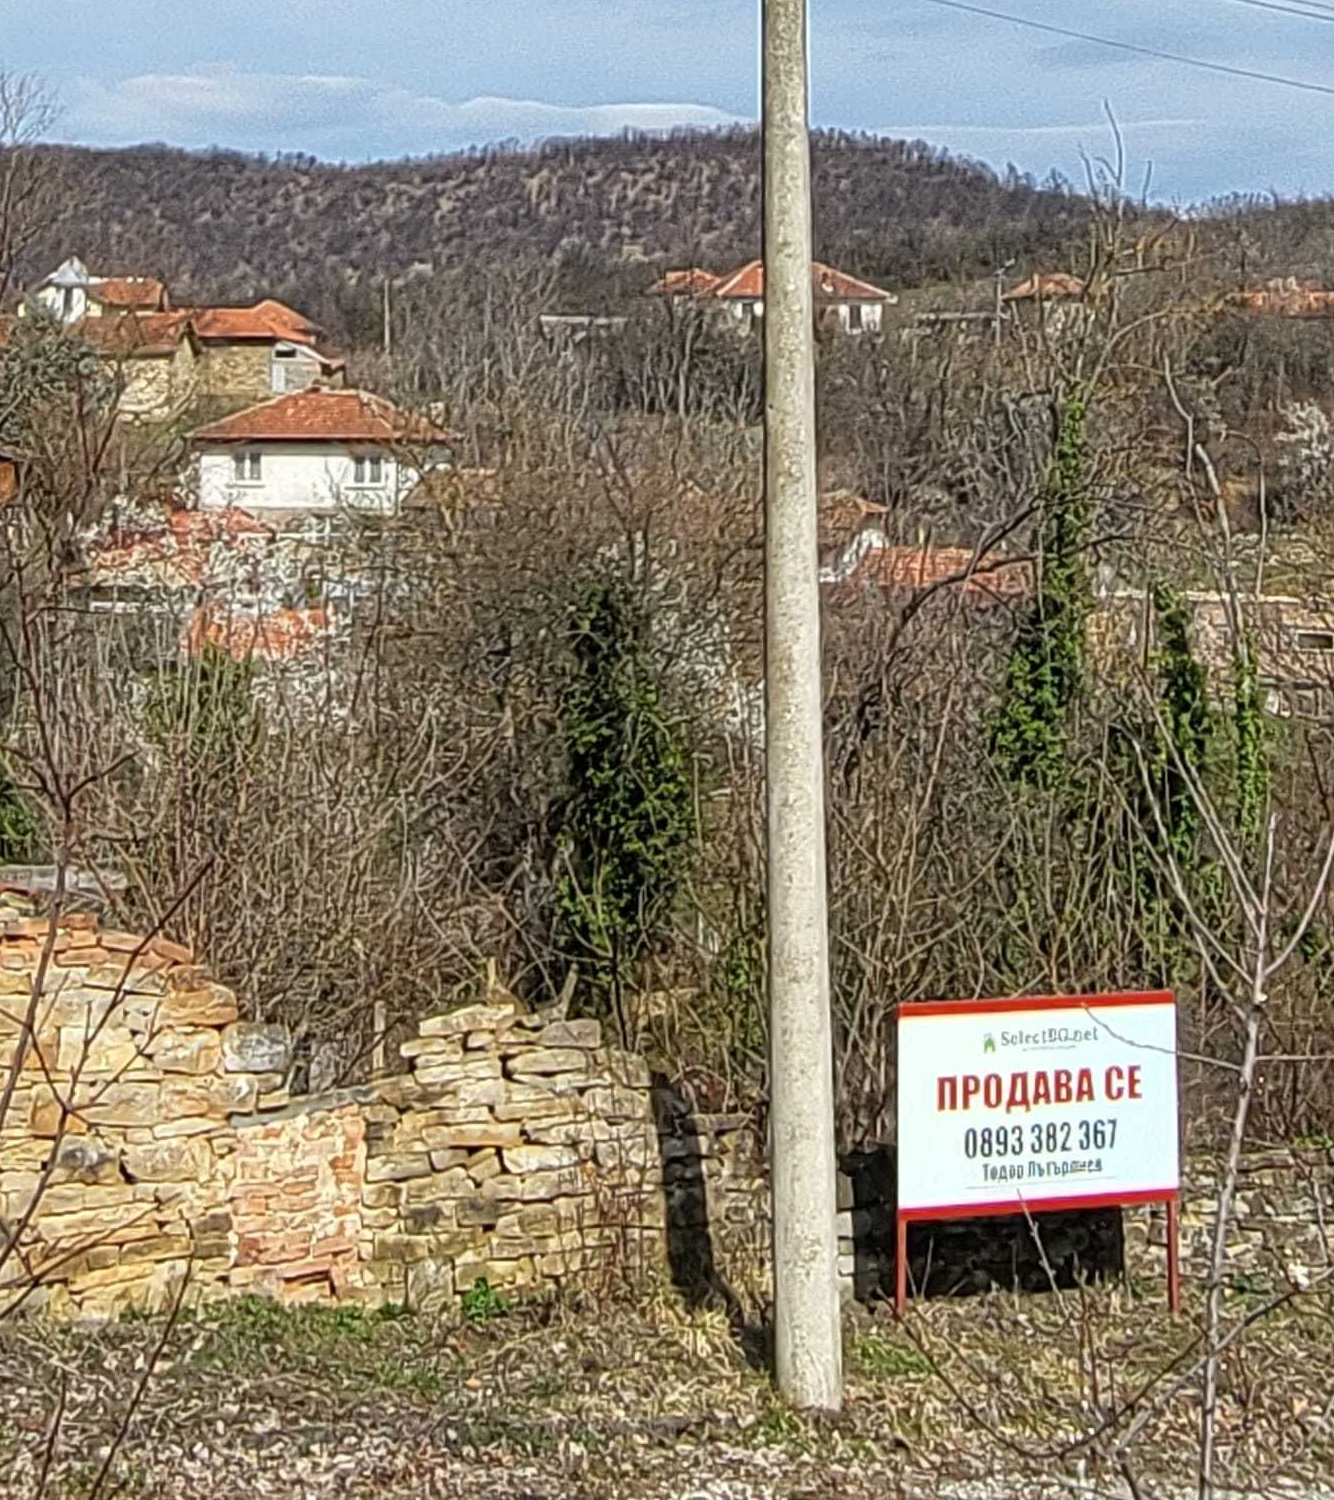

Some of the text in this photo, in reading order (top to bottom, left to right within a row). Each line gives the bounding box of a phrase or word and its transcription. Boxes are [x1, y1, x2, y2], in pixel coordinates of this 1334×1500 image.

[937, 1065, 1142, 1114] ПРОДАВА СЕ
[964, 1118, 1118, 1159] 0893 382 367
